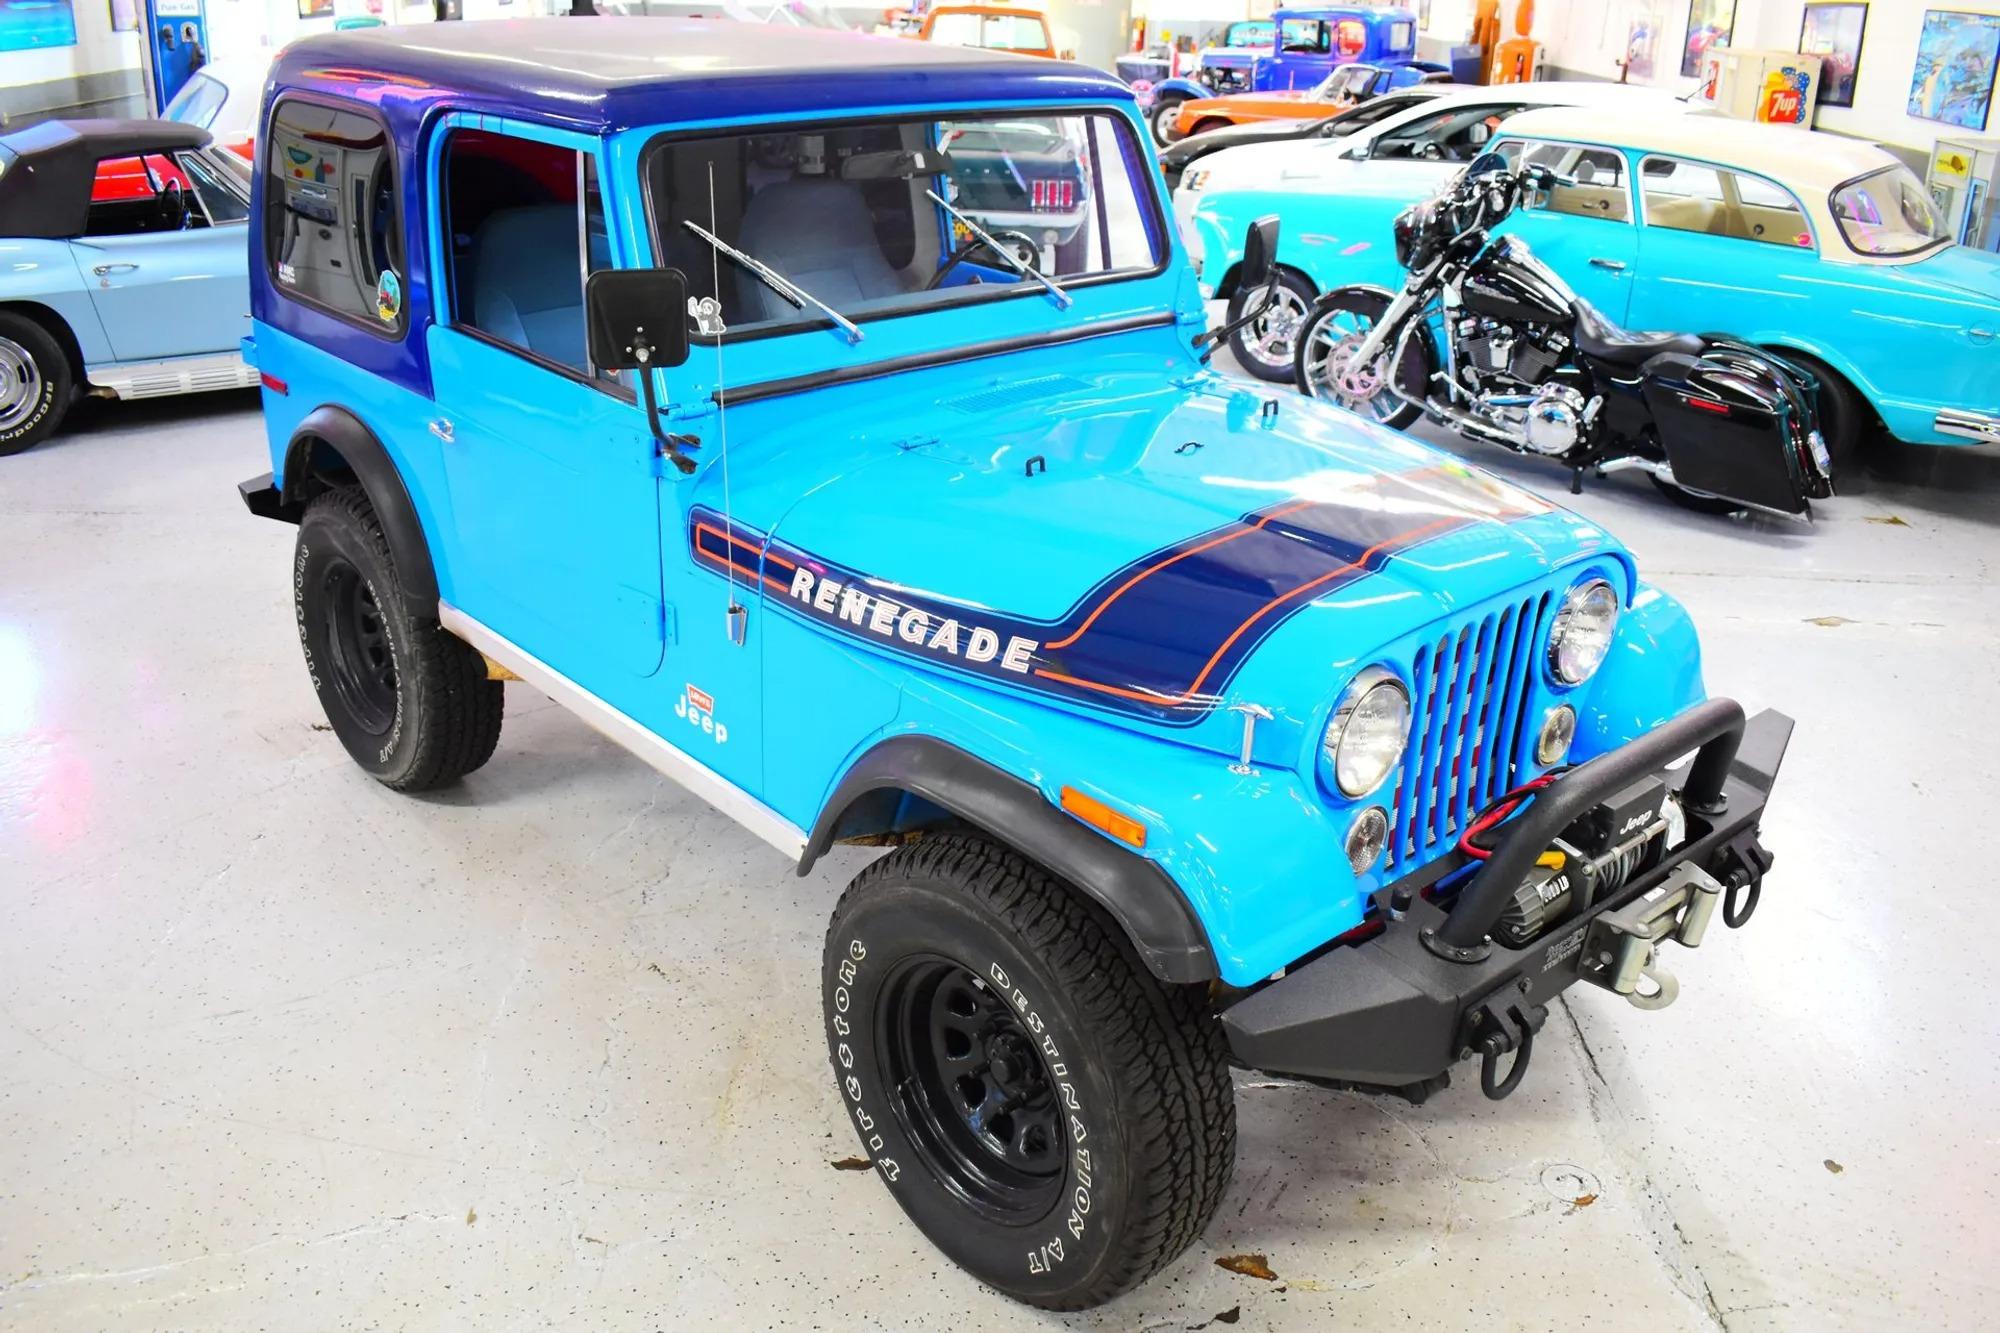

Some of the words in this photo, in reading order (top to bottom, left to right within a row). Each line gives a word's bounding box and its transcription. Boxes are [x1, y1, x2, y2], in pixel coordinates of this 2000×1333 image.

[1770, 92, 1797, 118] 7up
[790, 567, 1039, 674] RENEGADE
[674, 694, 728, 745] Jeep
[1620, 810, 1652, 835] Jeep
[833, 939, 900, 1182] Firestone
[991, 962, 1093, 1240] DESTINATION
[1029, 1238, 1065, 1274] A/T
